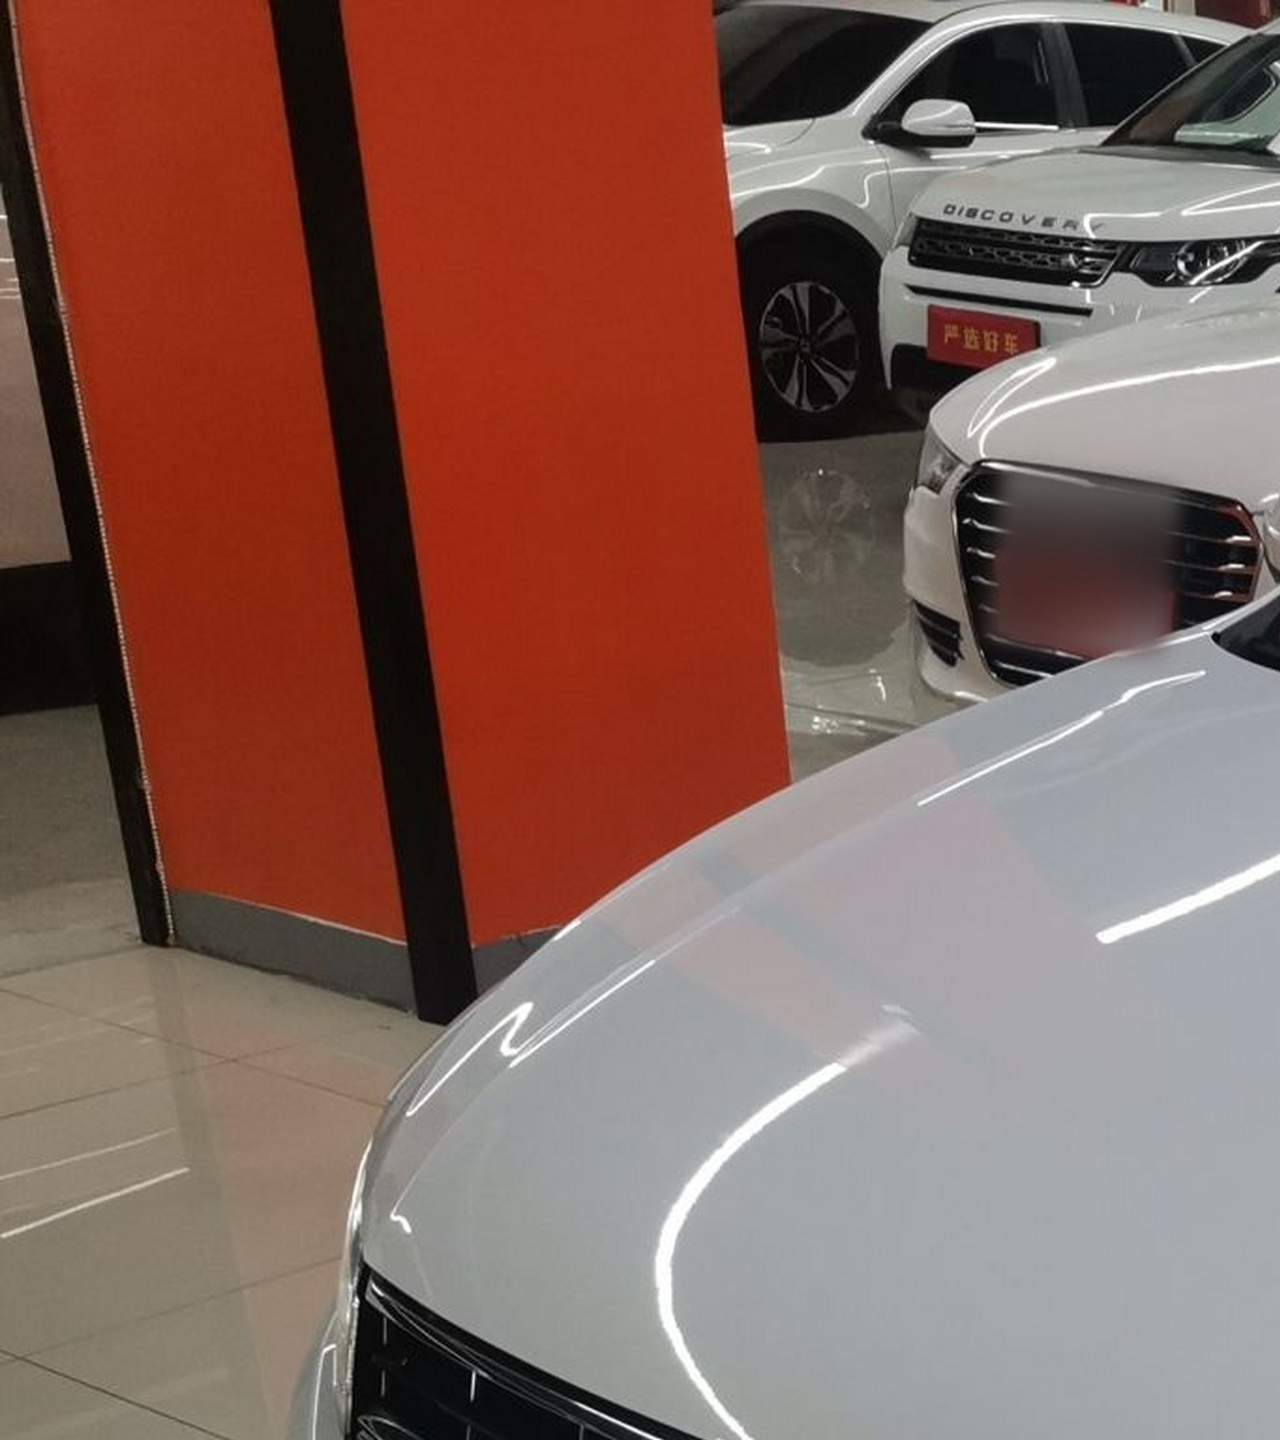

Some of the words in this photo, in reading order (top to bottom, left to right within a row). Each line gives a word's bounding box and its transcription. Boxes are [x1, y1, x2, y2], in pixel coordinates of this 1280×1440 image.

[943, 203, 1105, 231] DISCOVERY
[944, 323, 1020, 355] 严选好车
